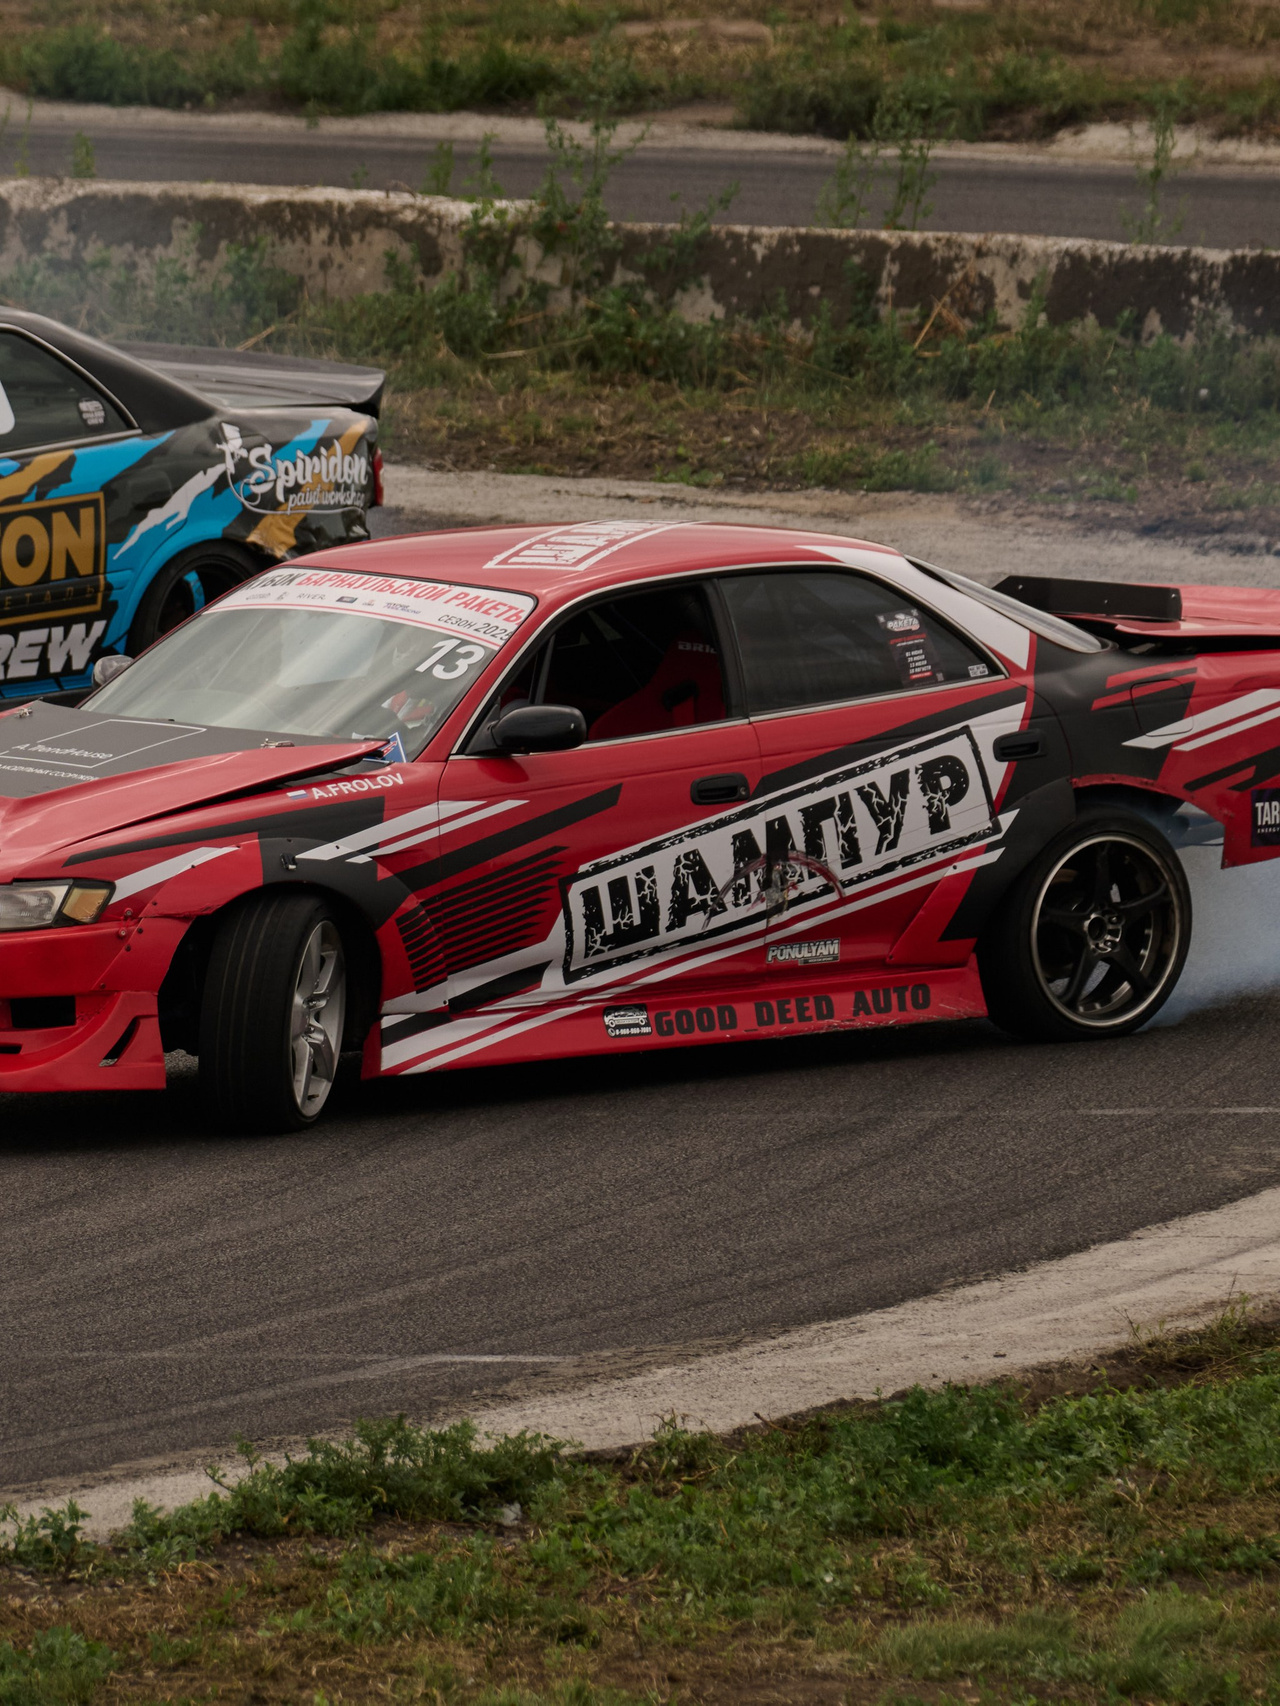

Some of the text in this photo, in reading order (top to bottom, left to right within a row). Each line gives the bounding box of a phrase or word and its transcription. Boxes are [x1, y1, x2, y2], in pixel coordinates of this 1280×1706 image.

[241, 439, 369, 505] Spiridon
[296, 572, 457, 602] БАРНАУЛЬСКОЙ
[437, 614, 476, 629] СЕЗОН
[415, 638, 485, 681] 13
[311, 772, 405, 800] A.FROLOV
[581, 755, 970, 959] ШАМПУР
[767, 939, 839, 962] PONULYAM
